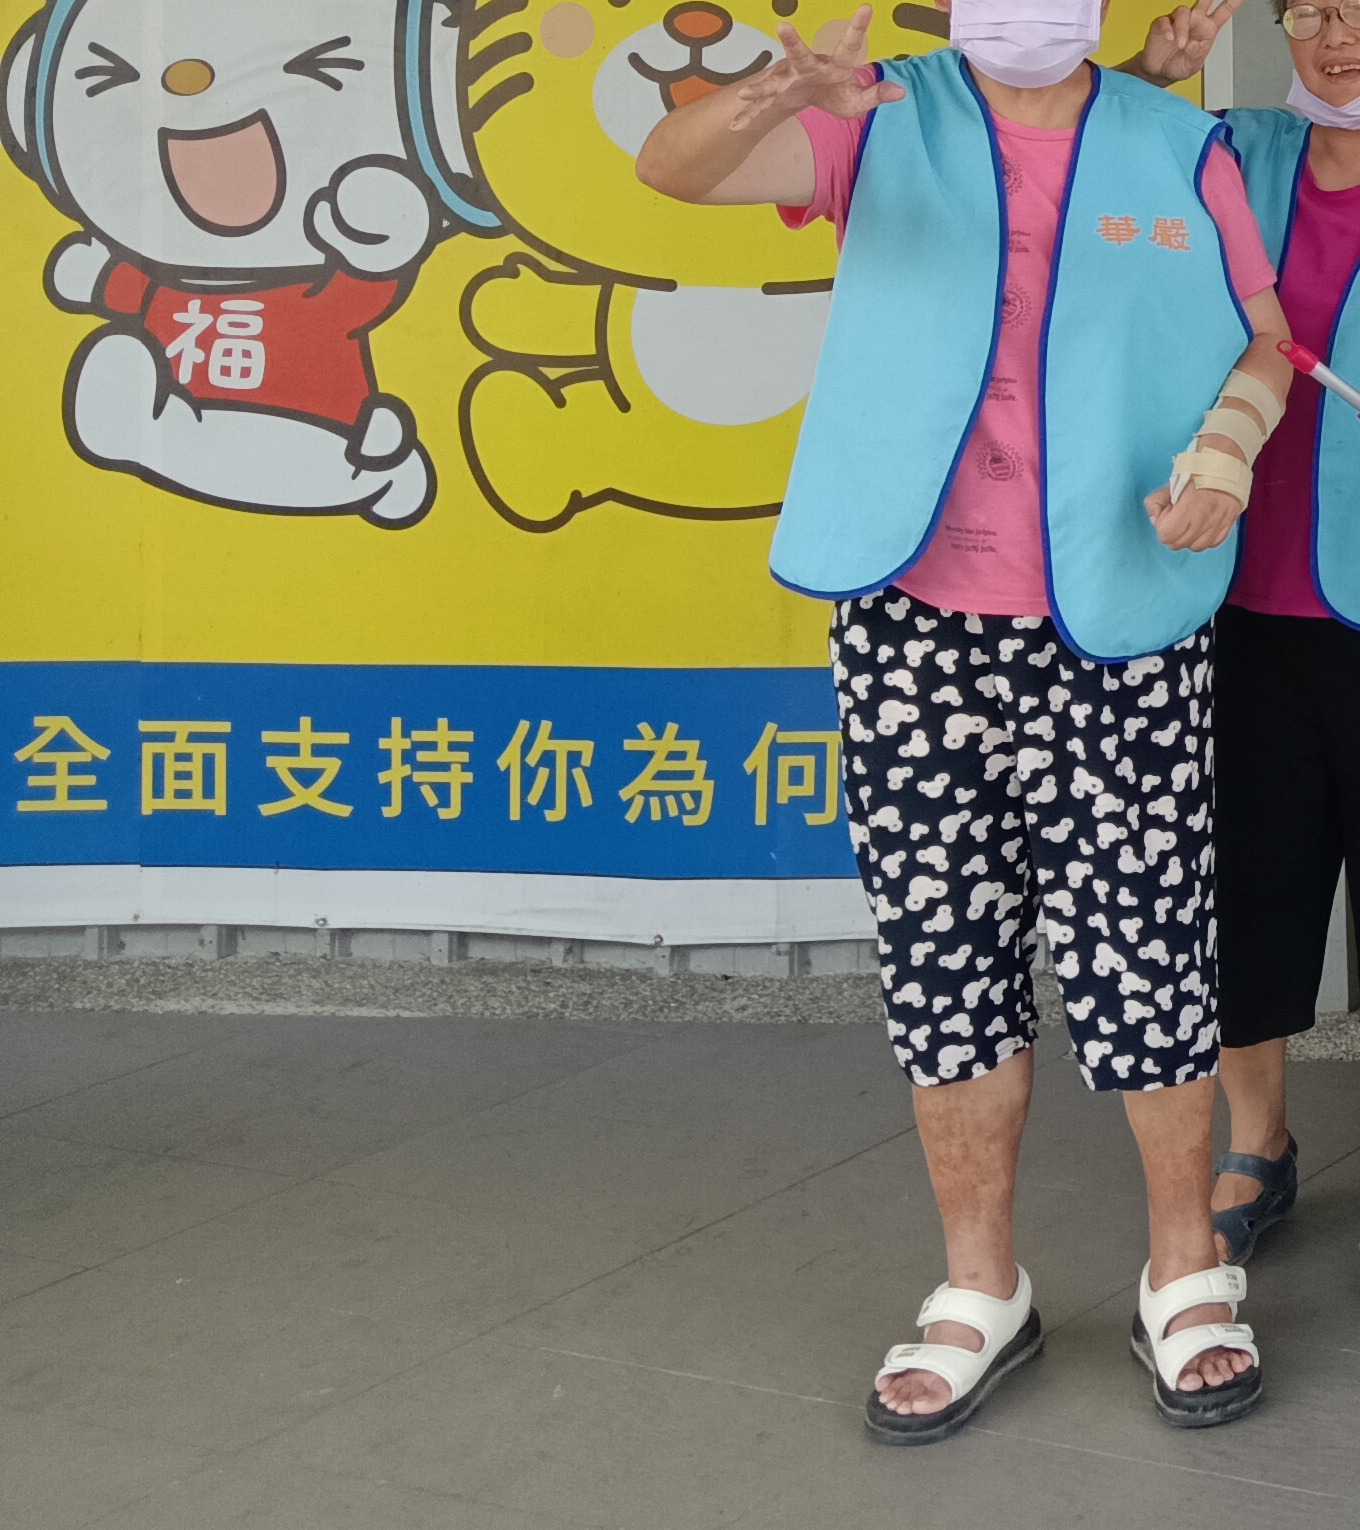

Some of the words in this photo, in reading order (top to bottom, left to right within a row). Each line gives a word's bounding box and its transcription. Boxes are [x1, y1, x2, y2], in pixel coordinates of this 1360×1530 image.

[1096, 214, 1191, 251] 華嚴
[166, 299, 265, 390] 福
[14, 716, 843, 827] 全面支持你為何
